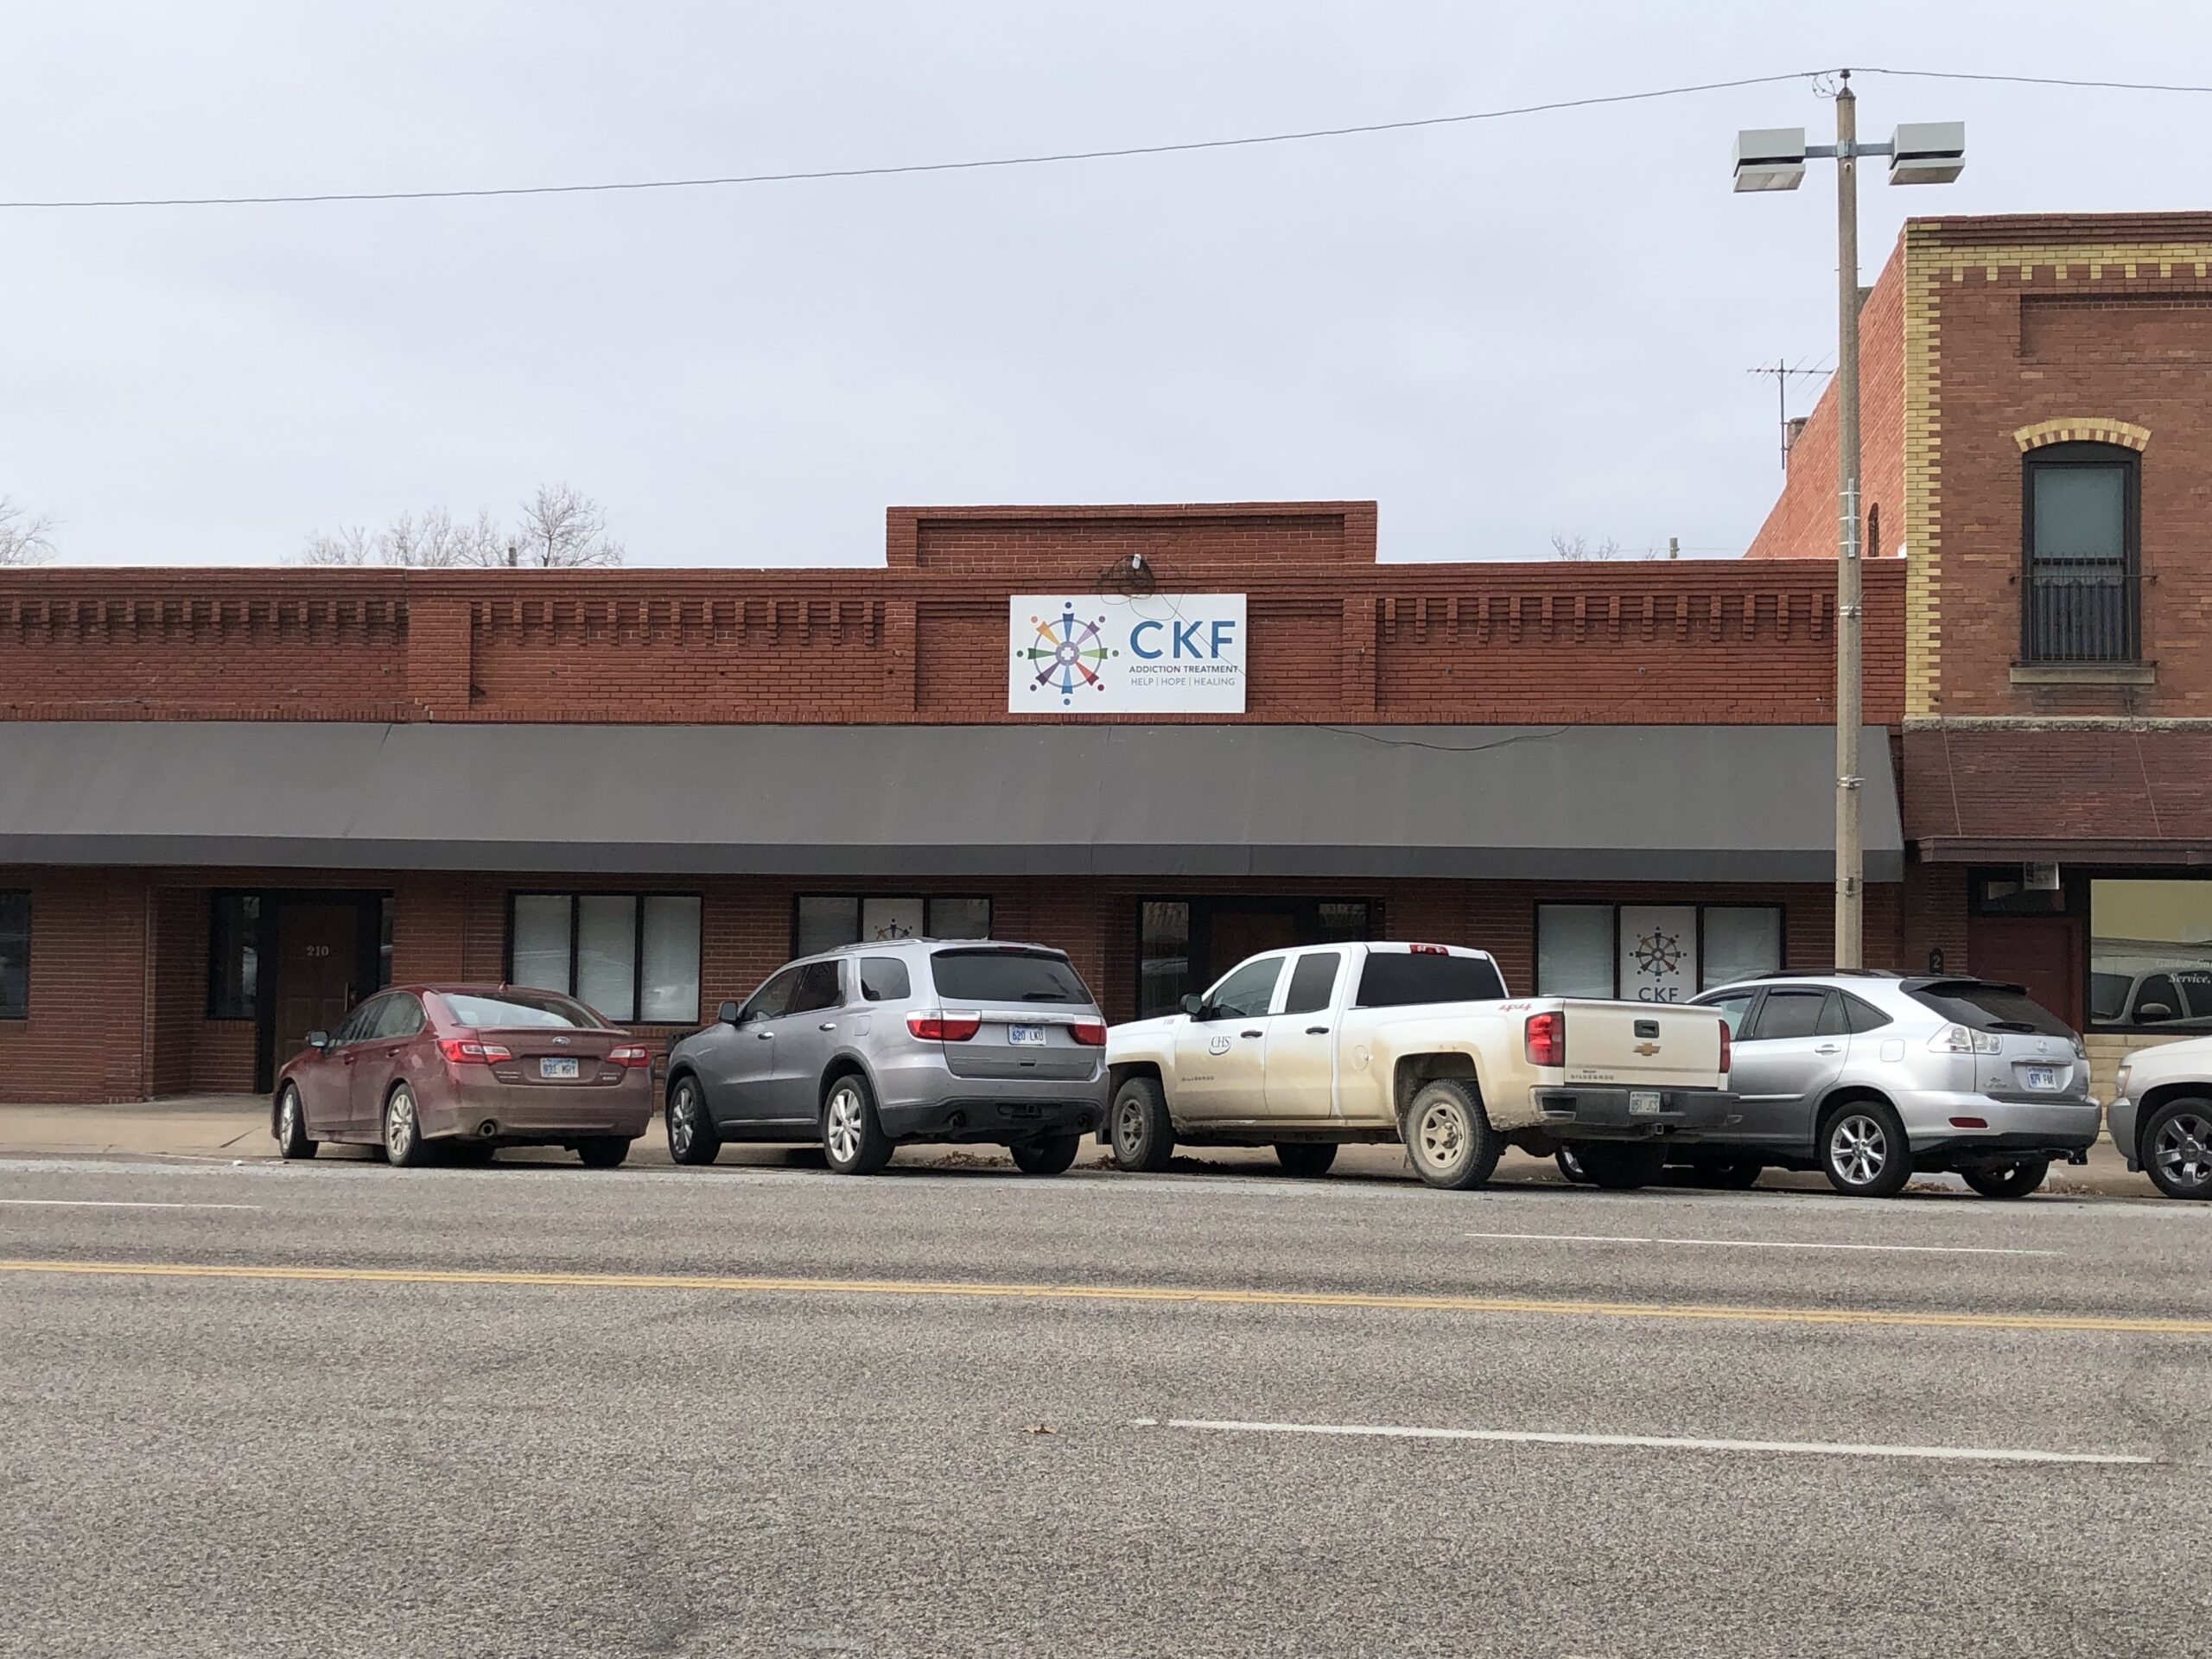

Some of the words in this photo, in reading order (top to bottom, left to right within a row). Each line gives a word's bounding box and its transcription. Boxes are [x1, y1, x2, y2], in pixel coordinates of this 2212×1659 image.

[1129, 620, 1236, 659] CKF
[1130, 677, 1154, 686] HELP
[1160, 677, 1186, 686] HOPE
[1193, 677, 1236, 686] HEALING
[306, 944, 330, 957] 210
[1932, 954, 1941, 969] 2
[1638, 987, 1679, 1001] CKF
[1012, 1030, 1026, 1040] 620
[1029, 1031, 1044, 1041] LKU
[1211, 1035, 1232, 1048] CHS
